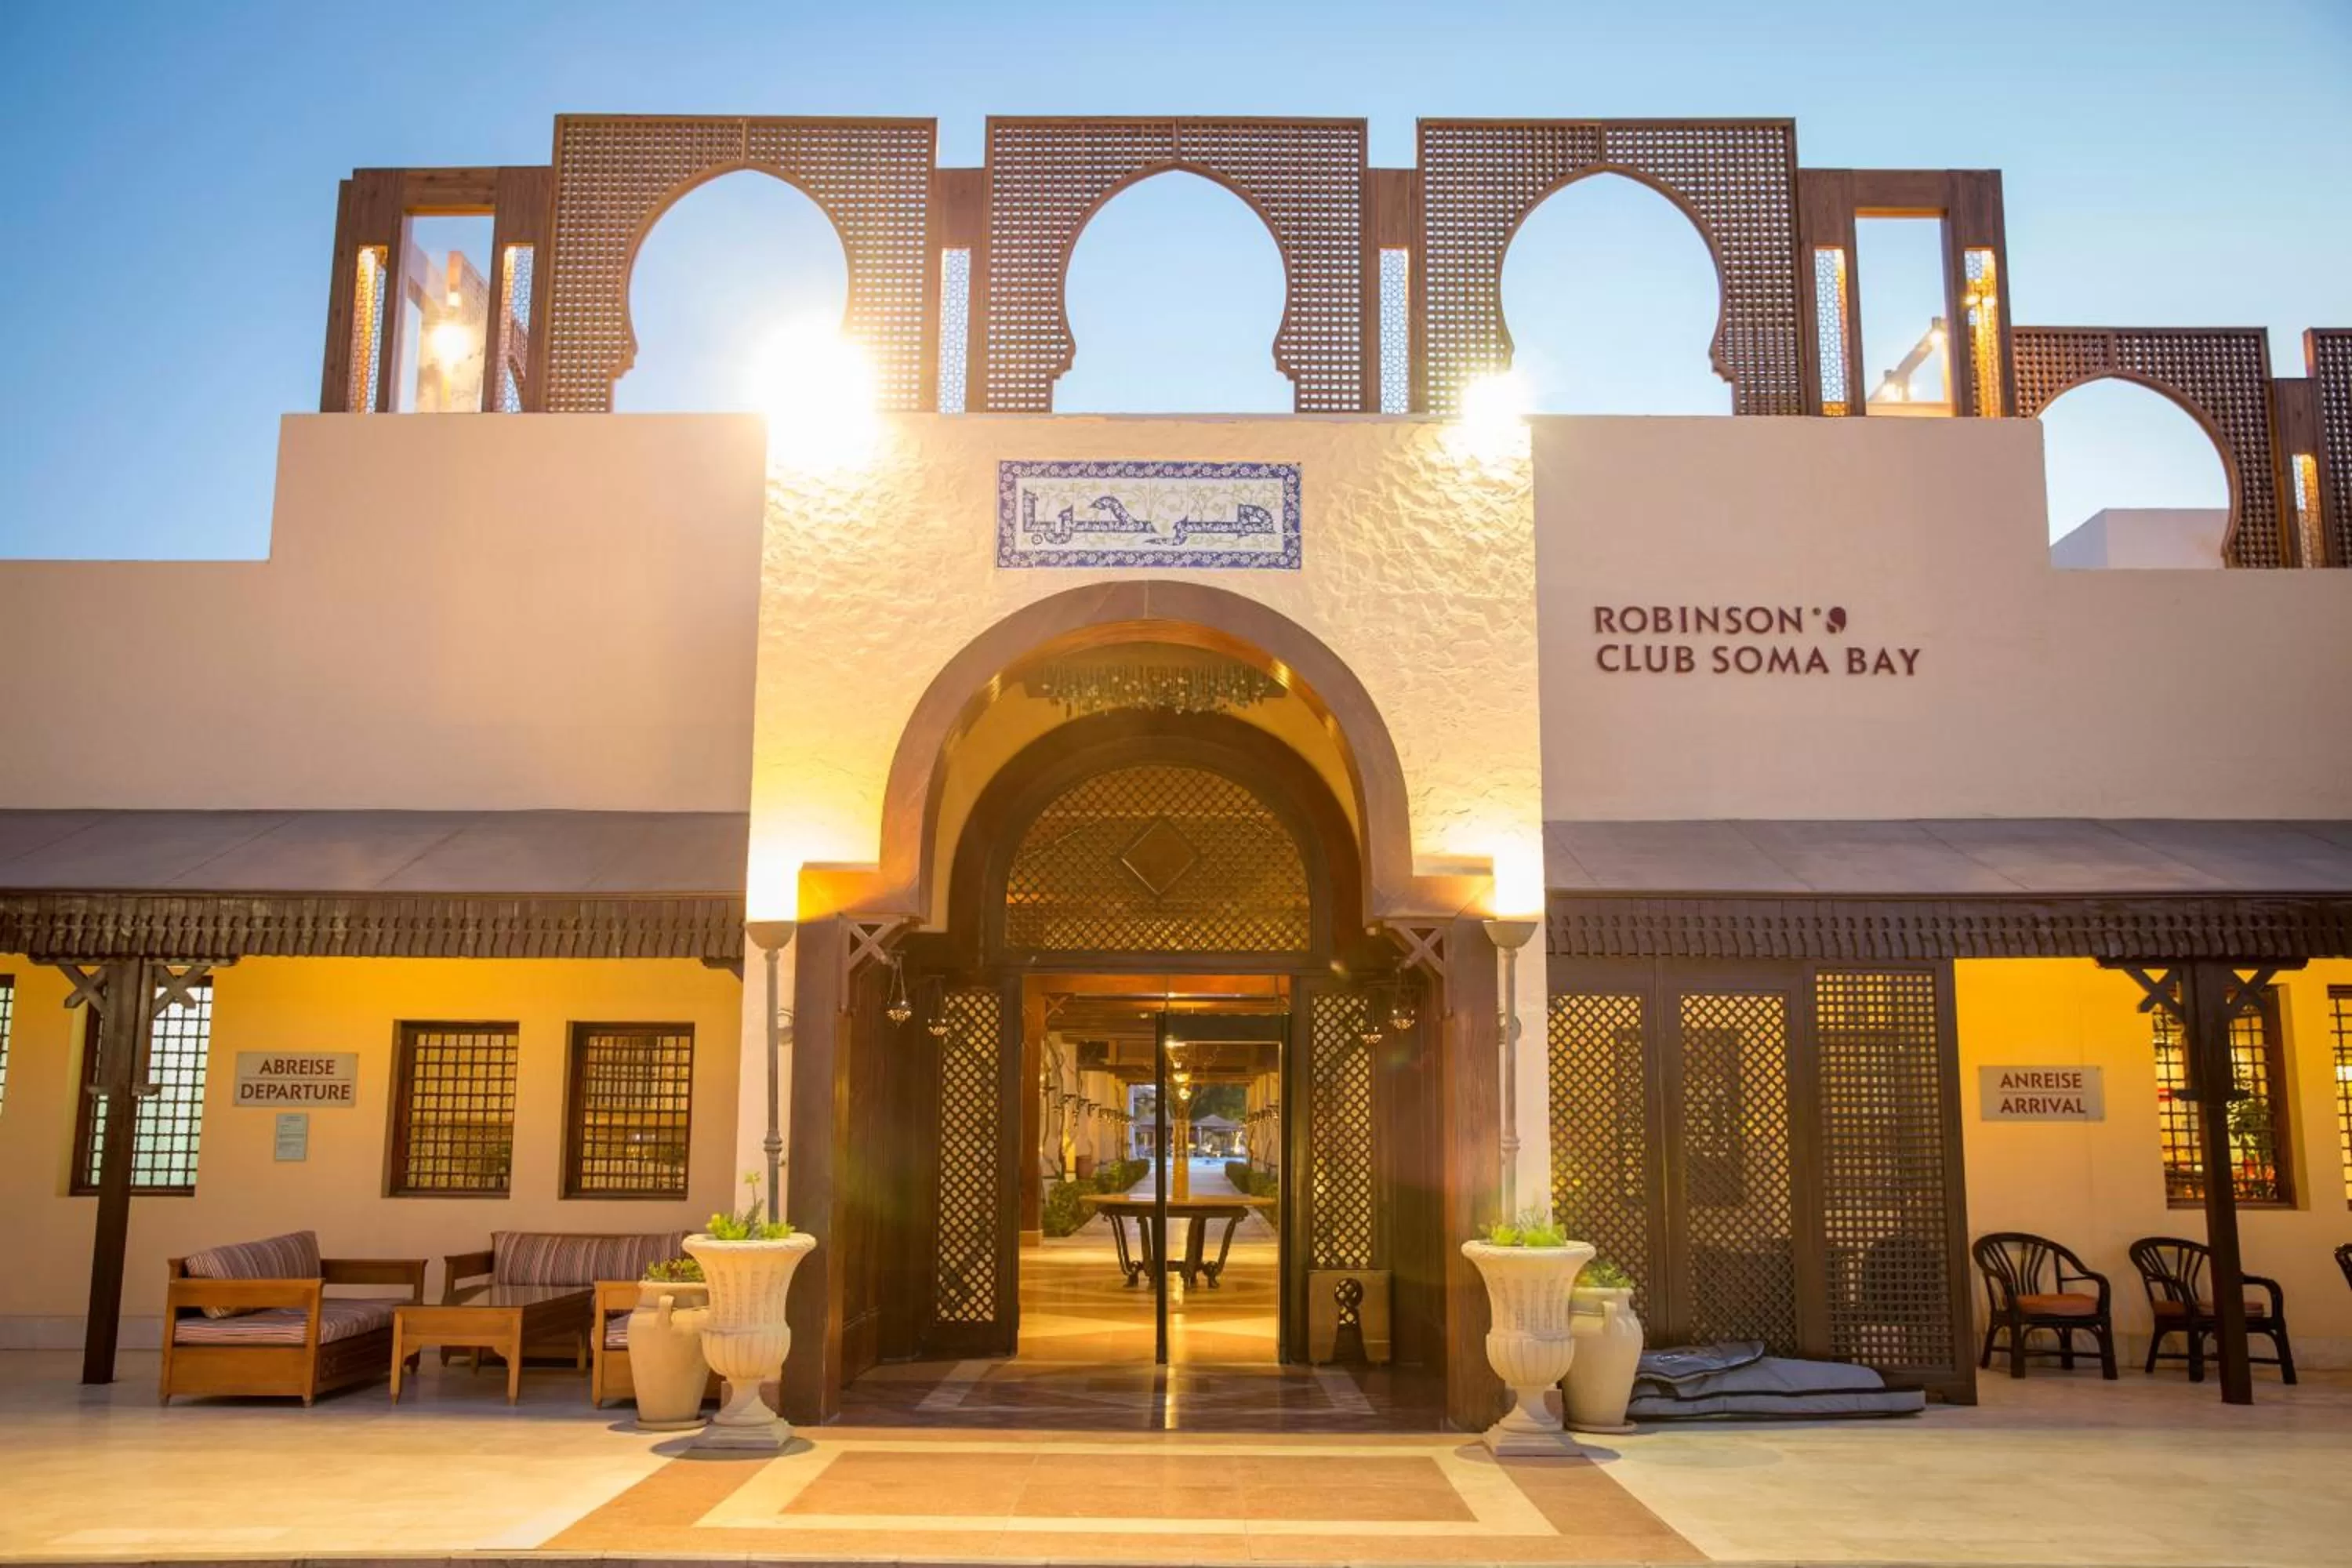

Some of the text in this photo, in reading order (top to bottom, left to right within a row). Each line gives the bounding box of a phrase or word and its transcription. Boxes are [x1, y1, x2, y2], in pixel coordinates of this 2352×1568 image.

[1593, 605, 1803, 633] ROBINSON
[1595, 644, 1922, 676] CLUB SOMA BAY
[259, 1059, 336, 1075] ABREISE
[1999, 1073, 2082, 1089] ANREISE
[240, 1083, 351, 1100] DEPARTURE
[1999, 1098, 2086, 1114] ARRIVAL
